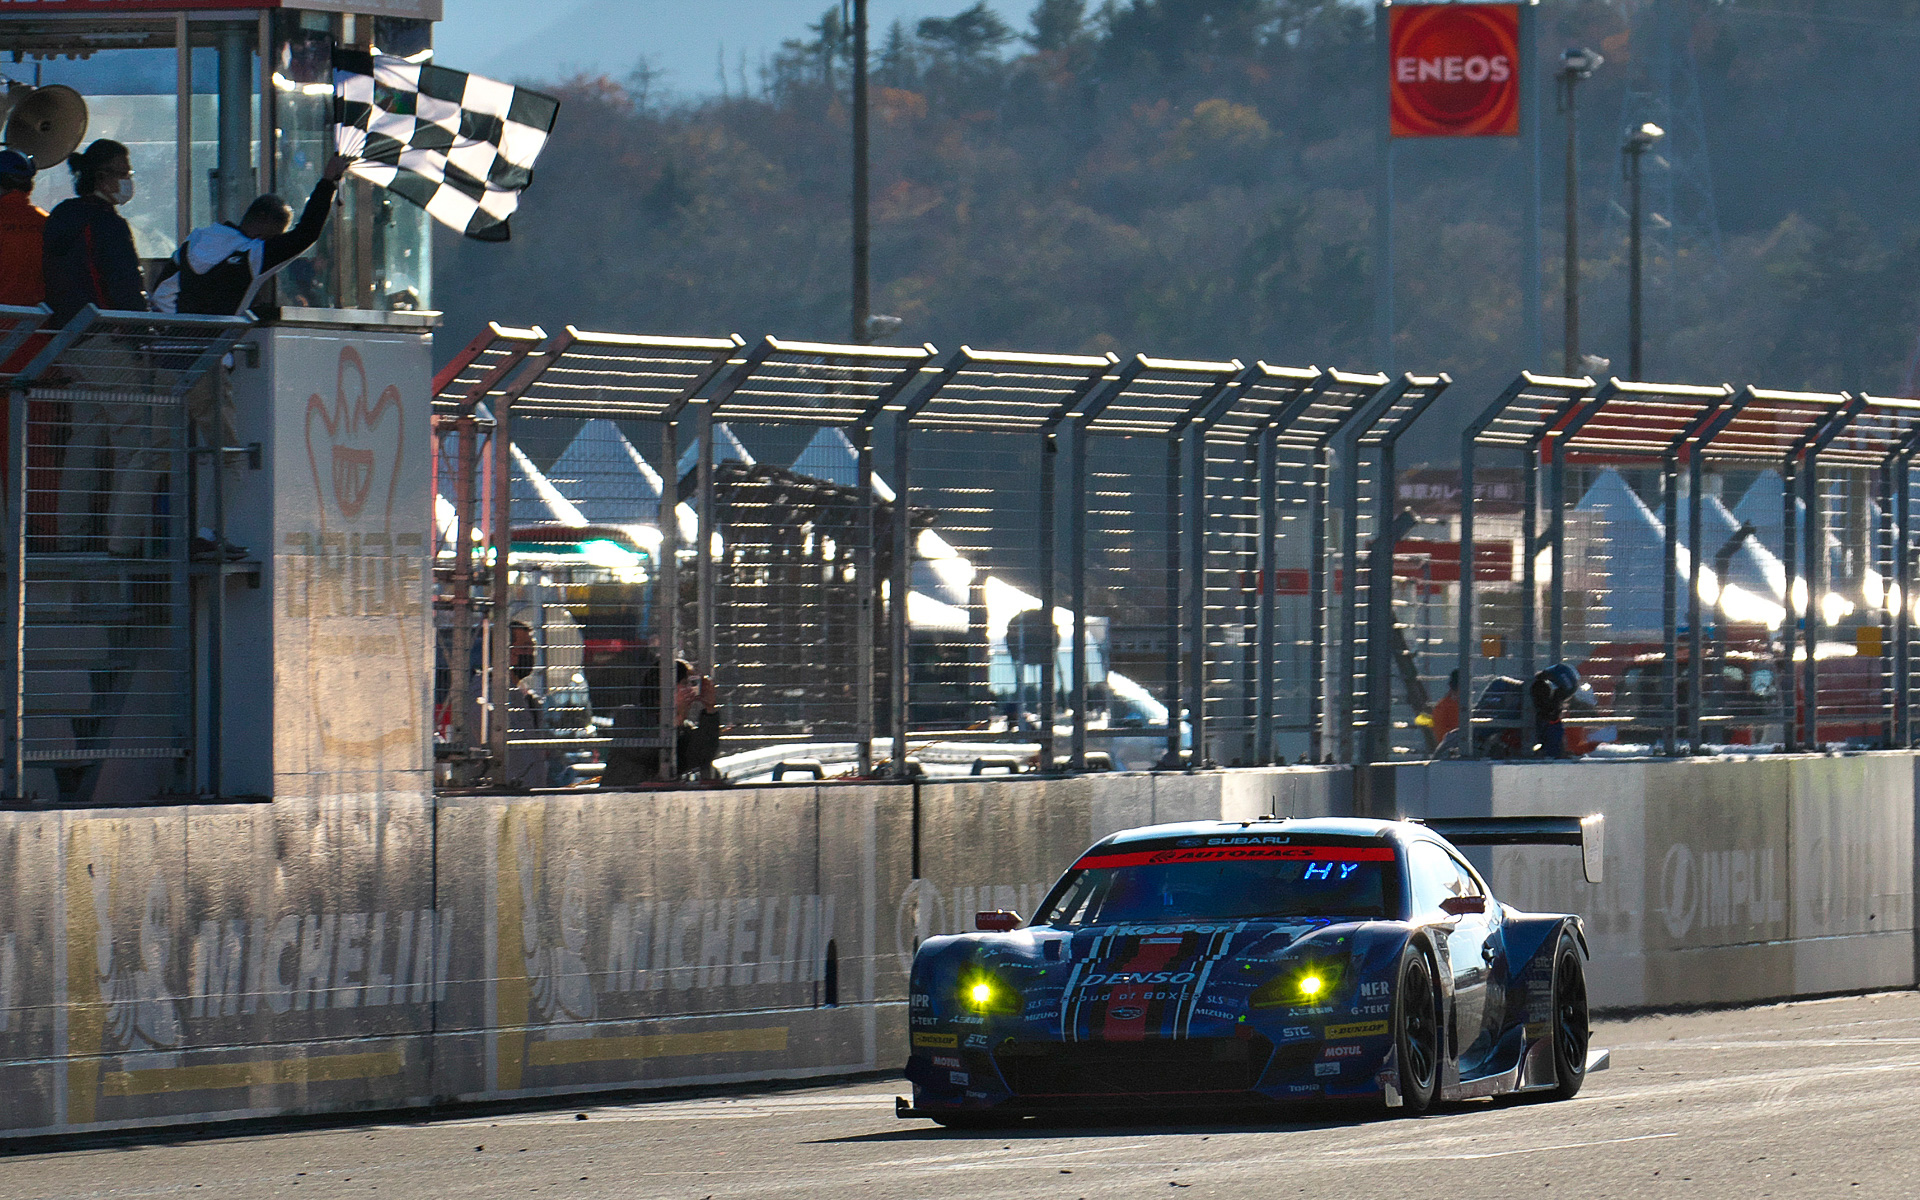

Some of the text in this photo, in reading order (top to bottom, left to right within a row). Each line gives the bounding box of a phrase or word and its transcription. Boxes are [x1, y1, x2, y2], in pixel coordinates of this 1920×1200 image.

[1396, 55, 1510, 83] ENEOS
[1207, 836, 1290, 846] SUBARU
[1174, 848, 1315, 861] AUTOBACS
[606, 894, 835, 992] MICHELIN
[191, 908, 454, 1018] MICHELIN
[1081, 972, 1196, 987] DENSO
[1195, 1008, 1234, 1020] MIZUHO
[1351, 1004, 1390, 1015] G-TEKT
[1024, 1011, 1059, 1021] MIZUHO
[1283, 1026, 1311, 1038] STC
[1338, 1024, 1385, 1034] DUNLOP
[1325, 1046, 1362, 1057] MOTUL
[934, 1056, 960, 1067] MOTUL
